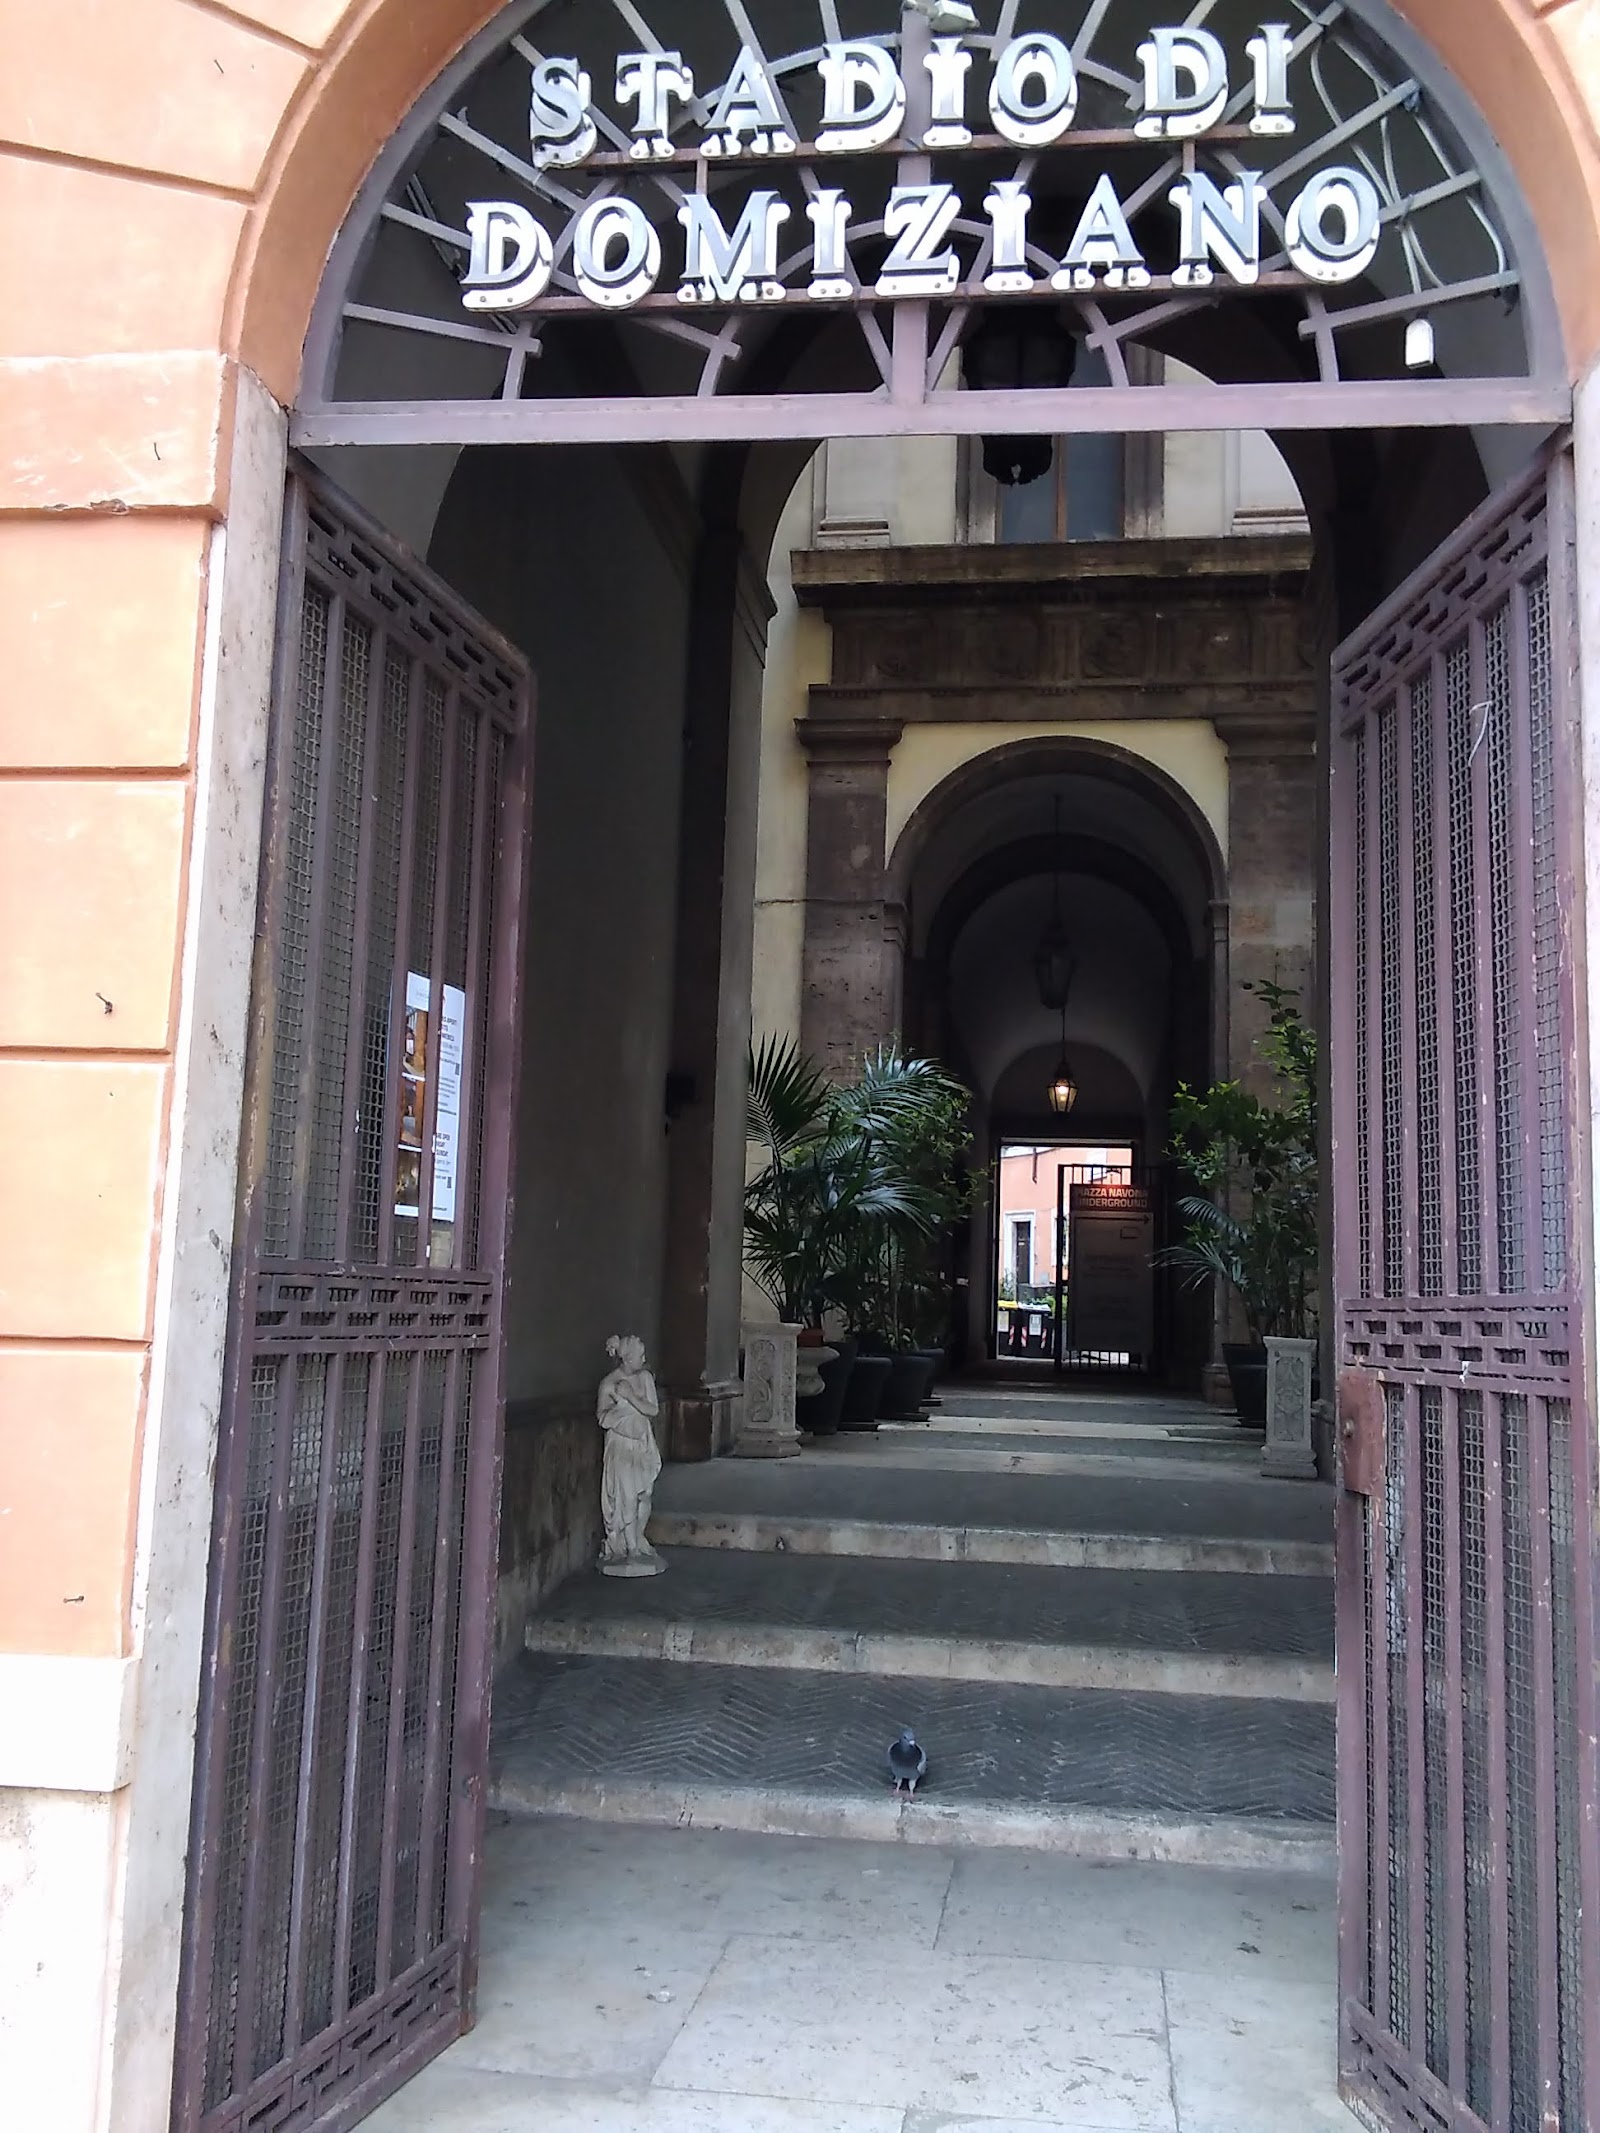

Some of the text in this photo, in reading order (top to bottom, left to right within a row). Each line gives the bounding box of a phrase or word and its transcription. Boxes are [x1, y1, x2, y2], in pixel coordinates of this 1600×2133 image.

[530, 24, 1296, 170] STADIO DI
[460, 166, 1380, 312] DOMIZIANO
